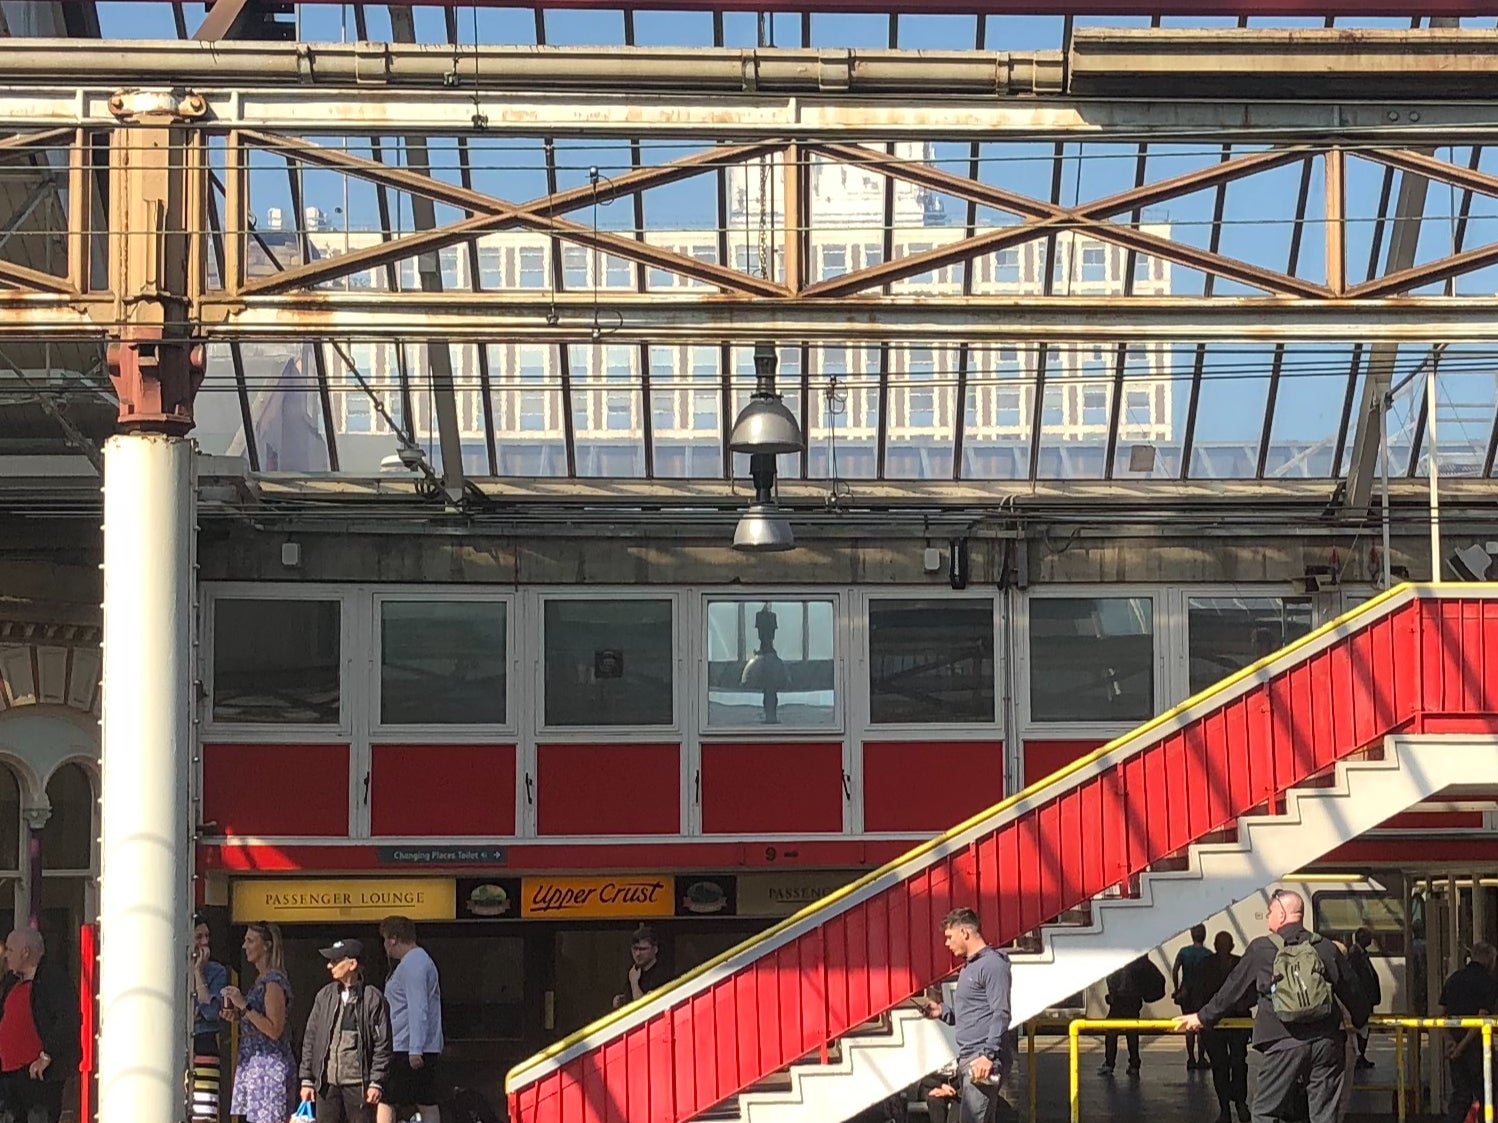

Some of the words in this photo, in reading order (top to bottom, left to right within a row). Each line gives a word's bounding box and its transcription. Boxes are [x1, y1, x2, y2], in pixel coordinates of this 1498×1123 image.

[393, 851, 430, 862] Changing
[431, 851, 456, 861] Places
[458, 851, 479, 861] Toilet
[765, 847, 777, 861] 9
[265, 893, 351, 905] PASSENGER
[361, 892, 425, 904] LOUNGE
[531, 884, 599, 911] Upper
[599, 881, 664, 904] Crust
